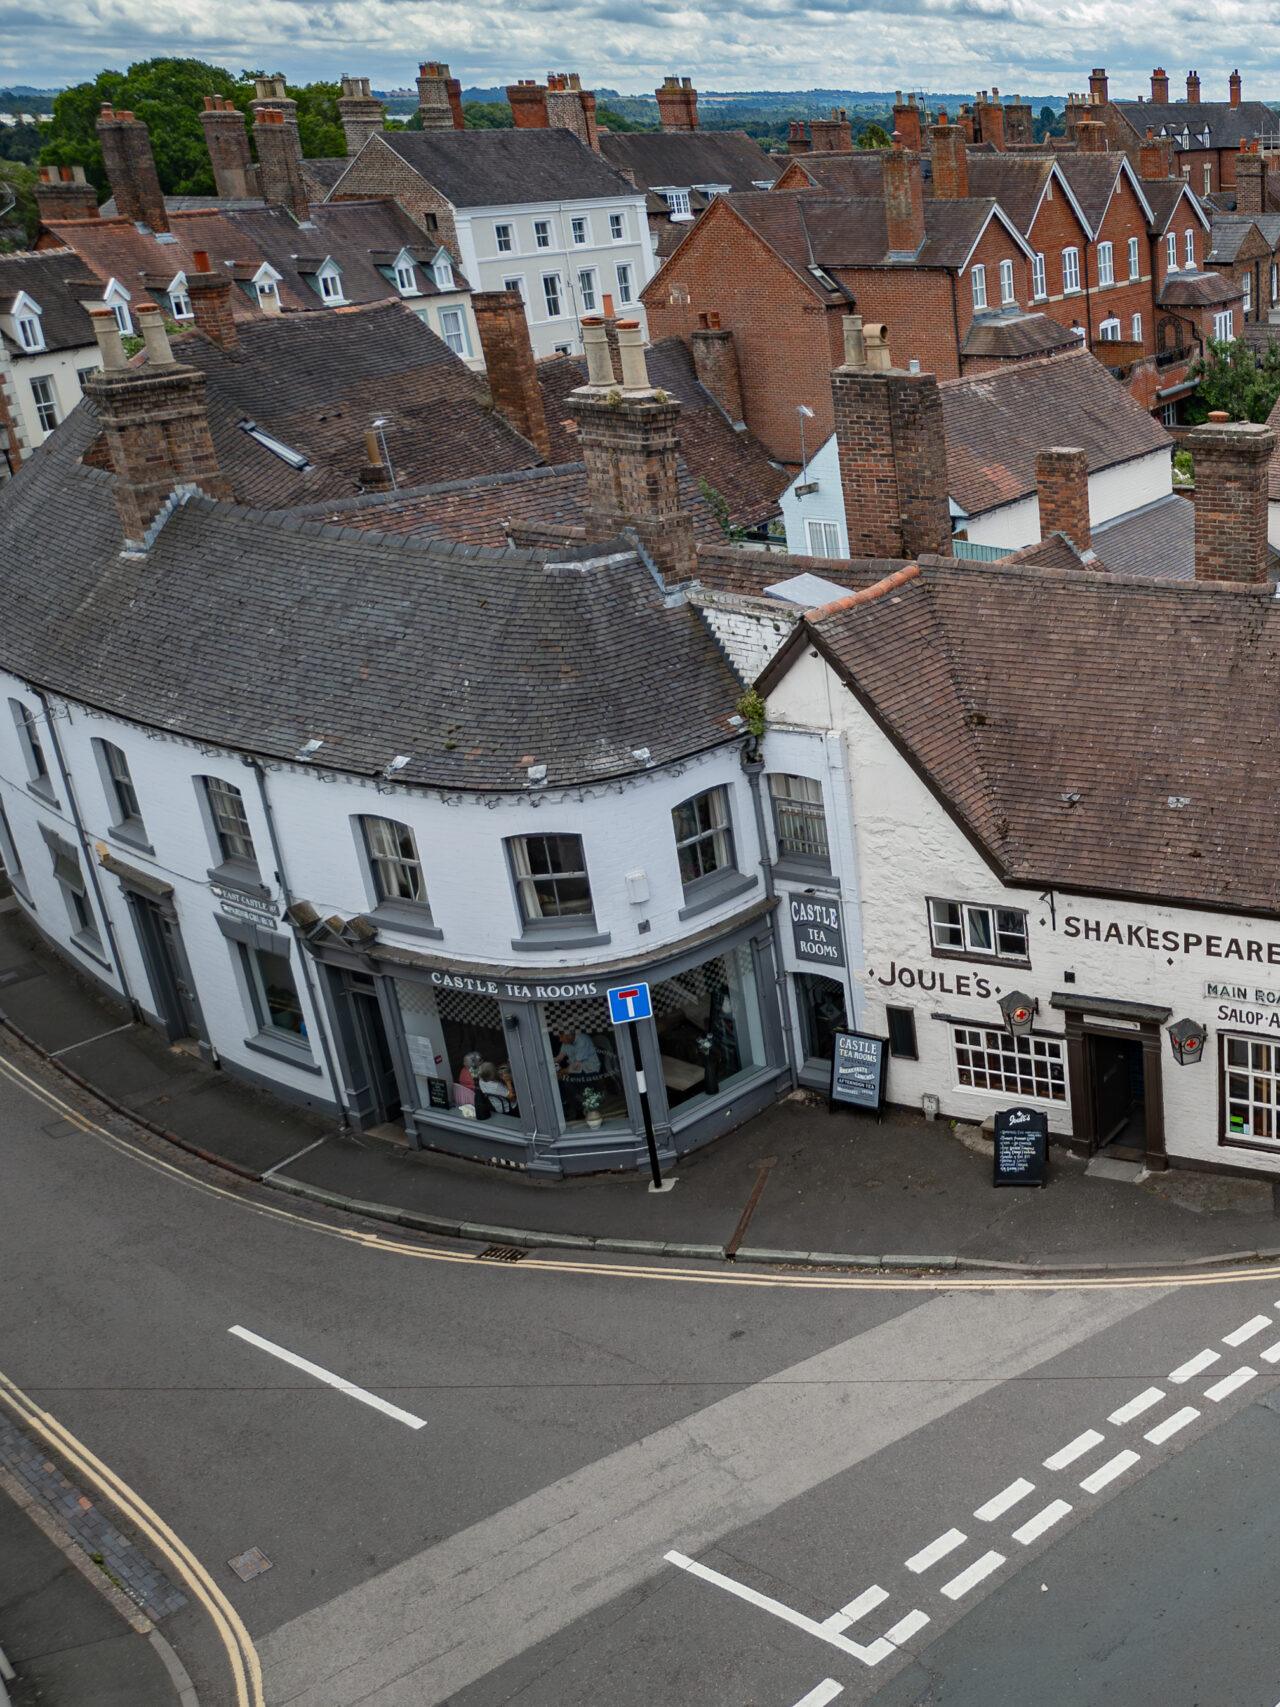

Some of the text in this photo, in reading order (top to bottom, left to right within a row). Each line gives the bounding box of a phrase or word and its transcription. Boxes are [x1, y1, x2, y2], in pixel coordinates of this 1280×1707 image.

[222, 889, 240, 901] EAST
[241, 895, 268, 911] CASTLE
[791, 901, 839, 929] CASTLE
[808, 928, 826, 943] TEA
[800, 940, 838, 958] ROOMS
[431, 972, 598, 998] CASTLE TEA ROOMS
[877, 961, 992, 999] JOULE'S
[1207, 983, 1248, 1000] MAIN
[839, 1037, 877, 1055] CASTLE
[839, 1048, 877, 1063] TEA ROOMS
[838, 1078, 865, 1087] AFTERNOON
